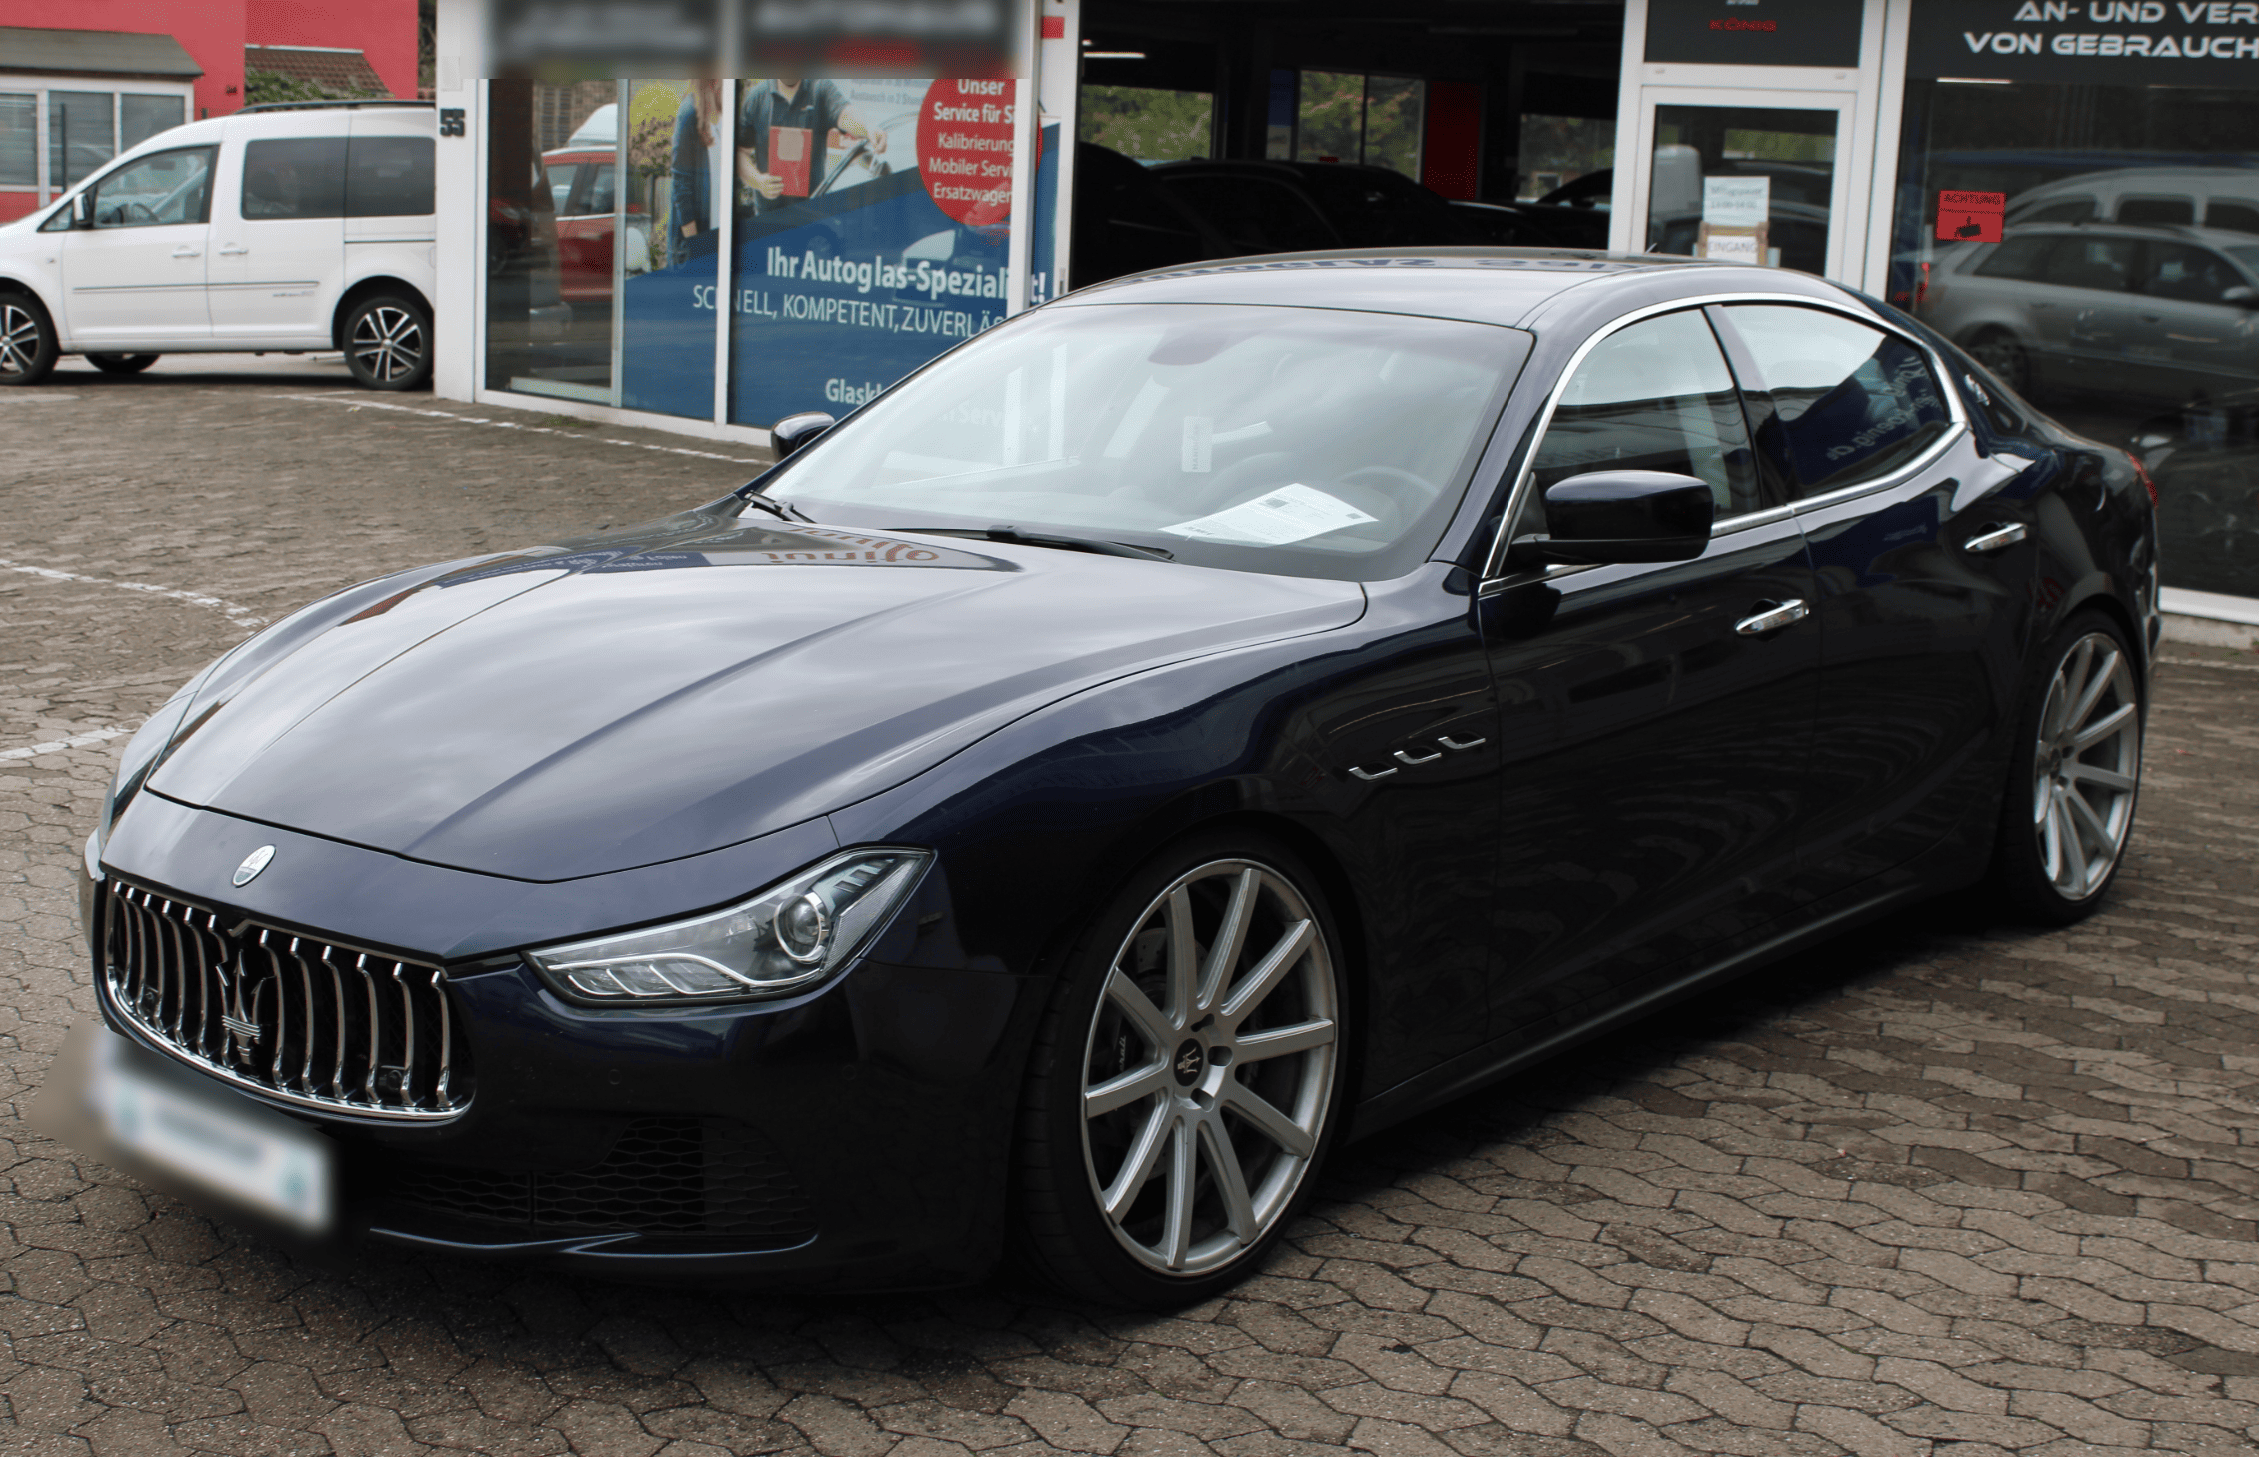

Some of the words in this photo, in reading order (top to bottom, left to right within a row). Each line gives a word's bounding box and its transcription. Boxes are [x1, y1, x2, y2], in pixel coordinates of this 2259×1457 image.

[2014, 1, 2080, 22] AN-
[2089, 1, 2166, 23] UND
[1709, 17, 1777, 32] KÖNIG
[1964, 32, 2043, 54] VON
[2052, 33, 2259, 59] GEBRAUCH
[958, 78, 1005, 95] Unser
[439, 108, 466, 138] 55
[934, 102, 979, 122] Service
[982, 103, 1002, 123] für
[929, 157, 978, 175] Mobiler
[1944, 194, 2001, 206] ACHTUNG
[767, 247, 799, 279] Ihr
[801, 250, 1046, 304] Autoglas-Spezialit!
